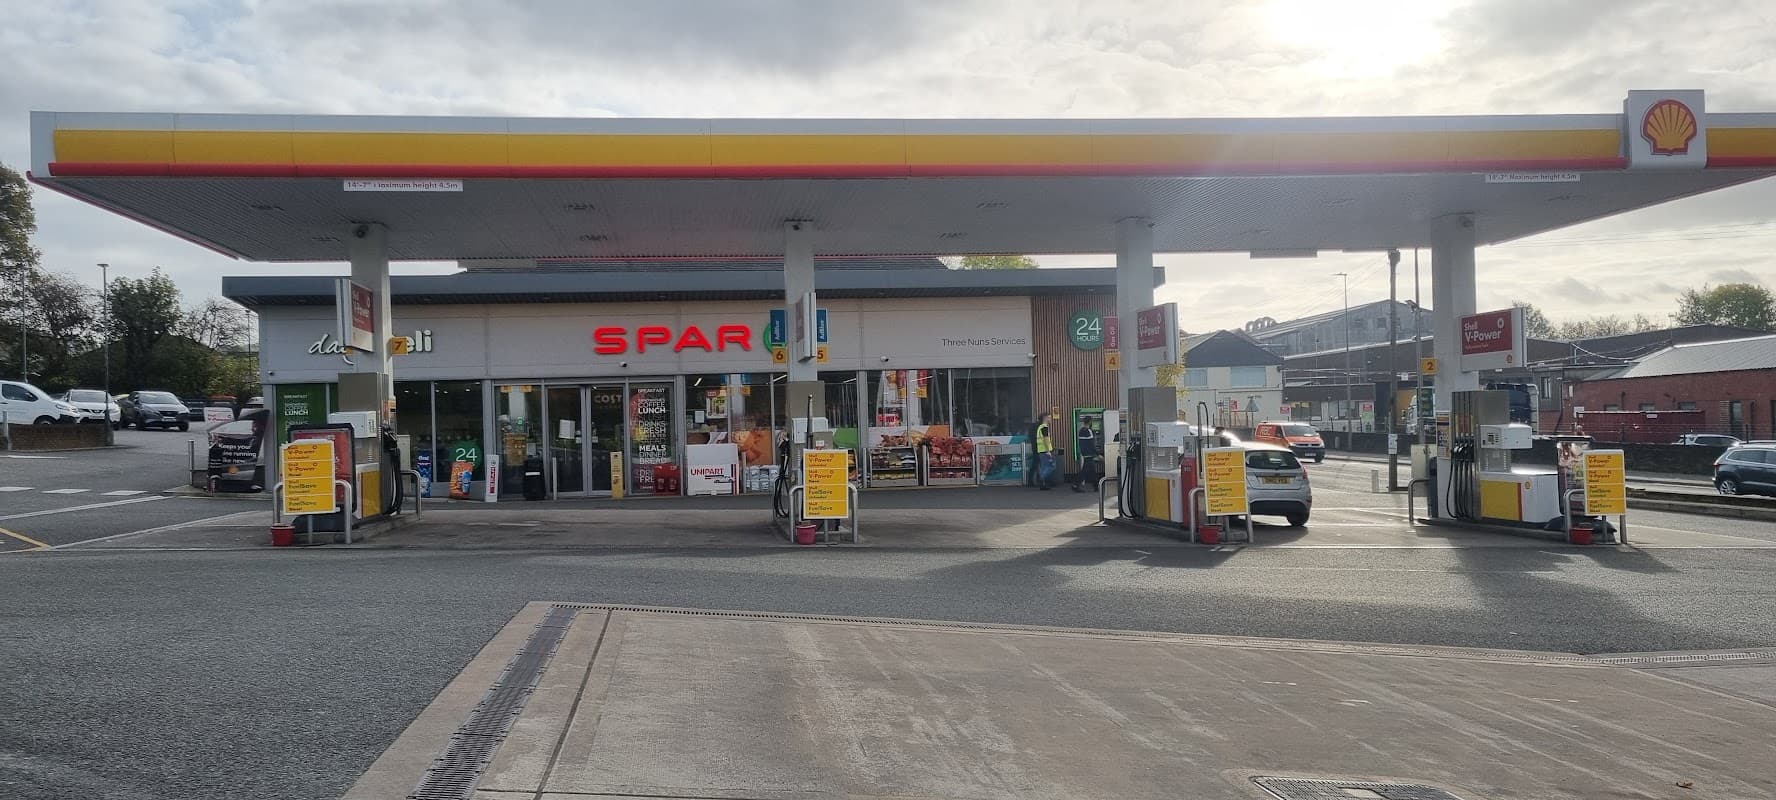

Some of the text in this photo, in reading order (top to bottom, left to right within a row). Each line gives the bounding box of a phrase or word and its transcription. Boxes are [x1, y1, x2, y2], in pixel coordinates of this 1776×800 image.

[1076, 318, 1102, 335] 24
[1464, 321, 1478, 330] Shell
[404, 330, 432, 352] eli
[594, 325, 752, 354] SPAR
[1464, 331, 1502, 342] V-Power
[394, 341, 403, 350] 7
[942, 338, 966, 346] Three
[991, 338, 1026, 346] Services
[776, 351, 784, 360] 6
[817, 350, 824, 360] 5
[1109, 356, 1116, 365] 4
[1427, 362, 1434, 370] 2
[594, 394, 622, 404] COST
[456, 448, 477, 462] 24
